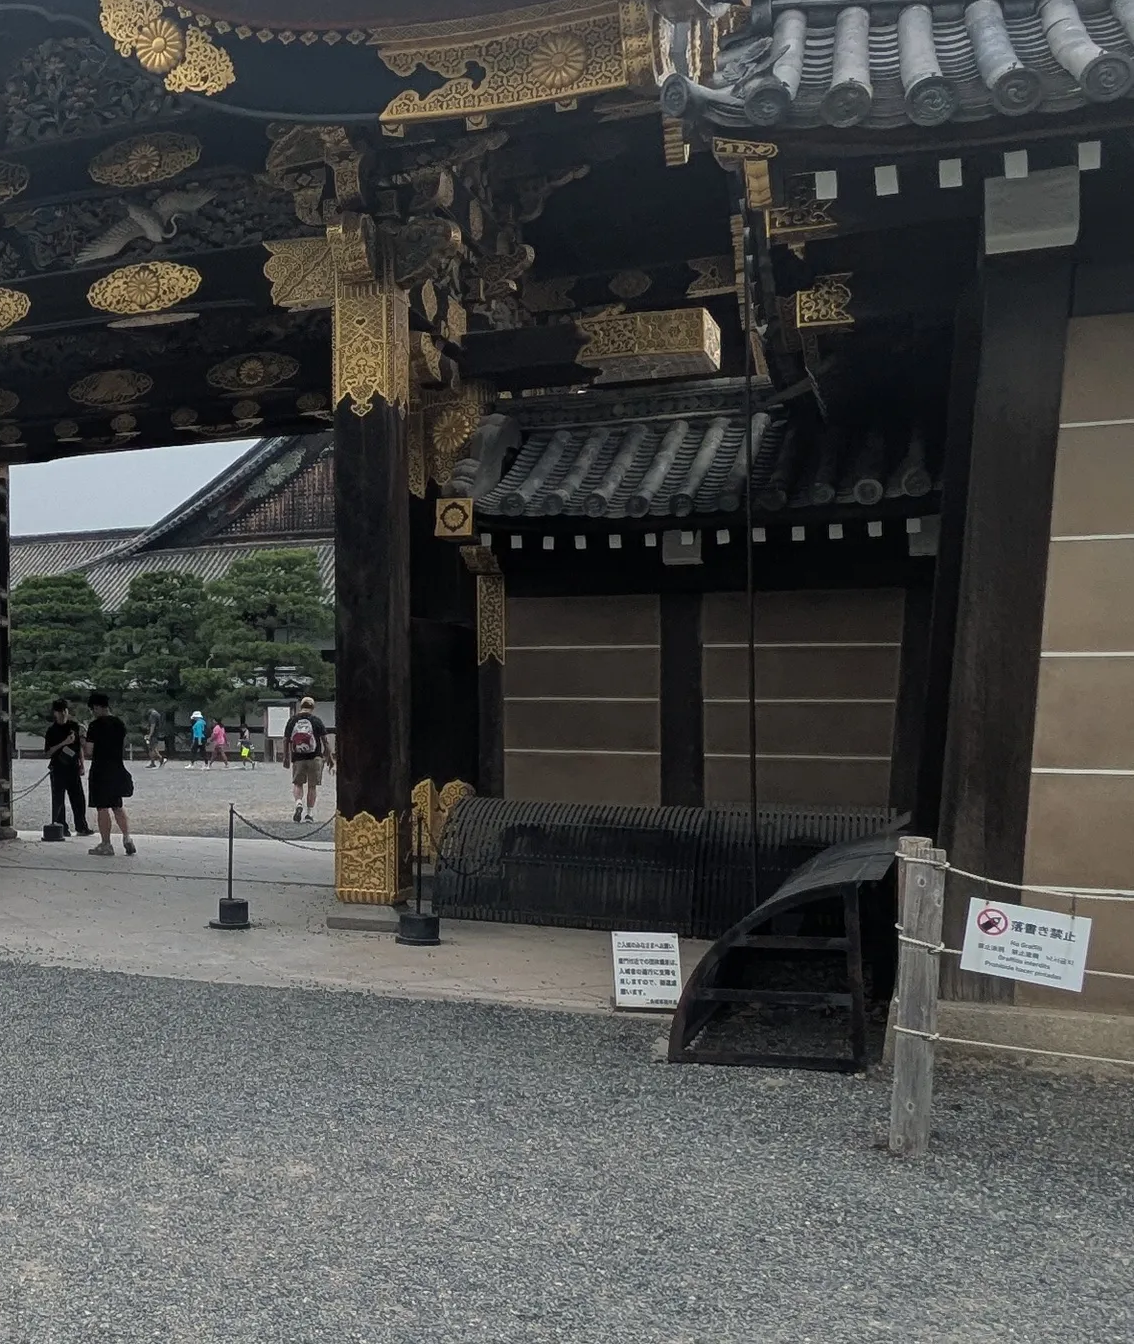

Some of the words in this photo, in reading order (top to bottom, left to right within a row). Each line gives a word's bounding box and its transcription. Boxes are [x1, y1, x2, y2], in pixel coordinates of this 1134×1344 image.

[1011, 921, 1076, 942] 落書き禁止
